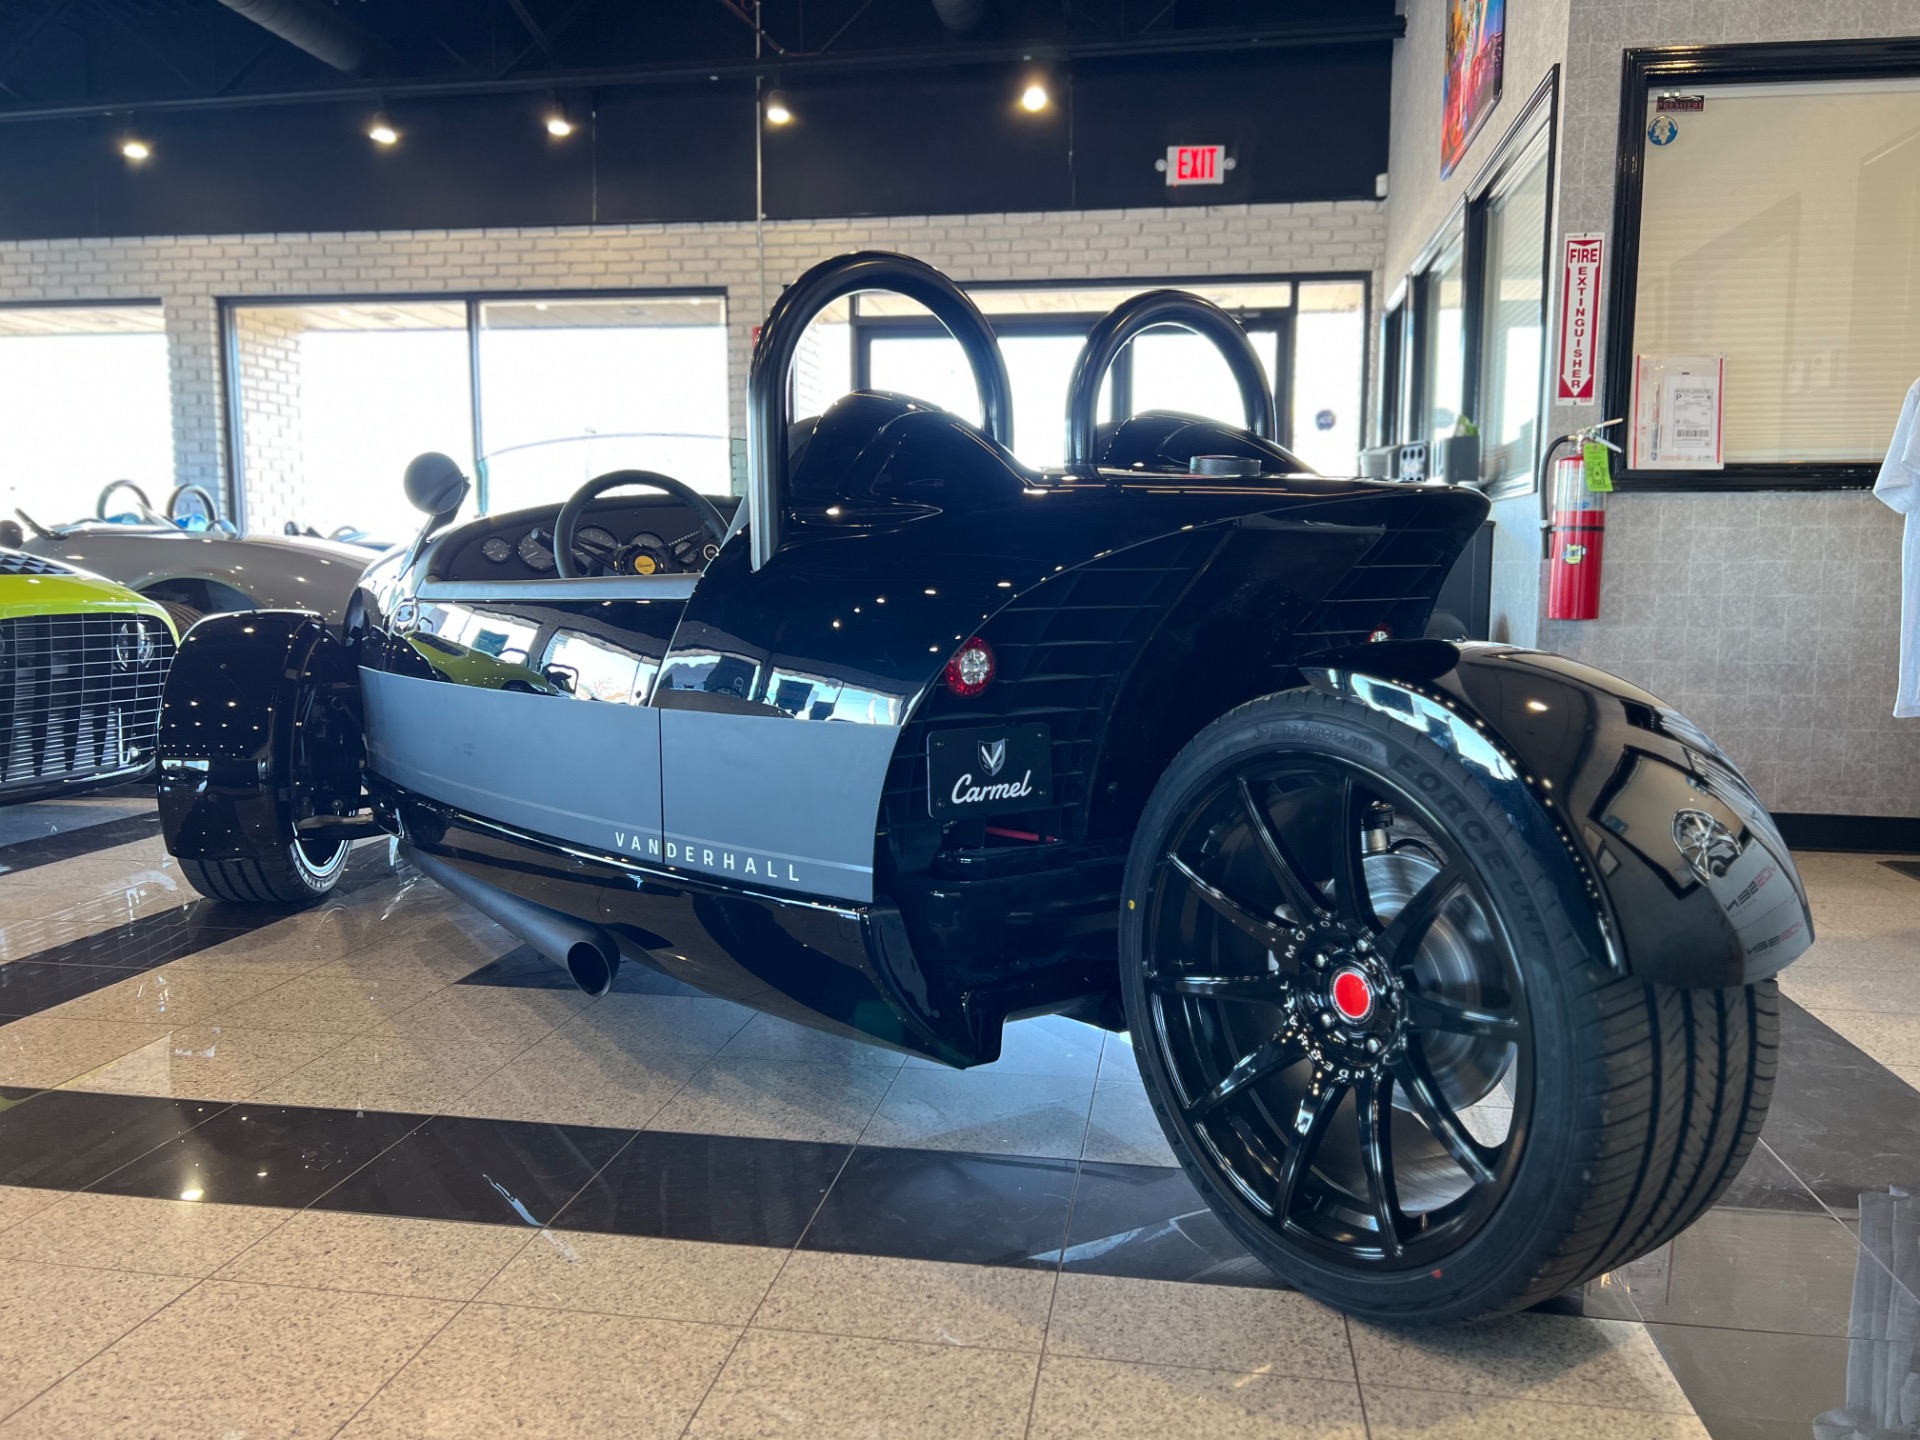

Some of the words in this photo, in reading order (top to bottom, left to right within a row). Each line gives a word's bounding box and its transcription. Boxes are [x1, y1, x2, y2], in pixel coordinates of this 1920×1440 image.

[1177, 147, 1218, 179] EXIT
[1569, 248, 1598, 263] FIRE
[1571, 266, 1588, 389] EXTINGUISHER
[951, 769, 1033, 804] Carmel
[615, 831, 800, 882] VANDERHALL
[1394, 753, 1510, 872] FORCE
[1510, 881, 1553, 948] UHP
